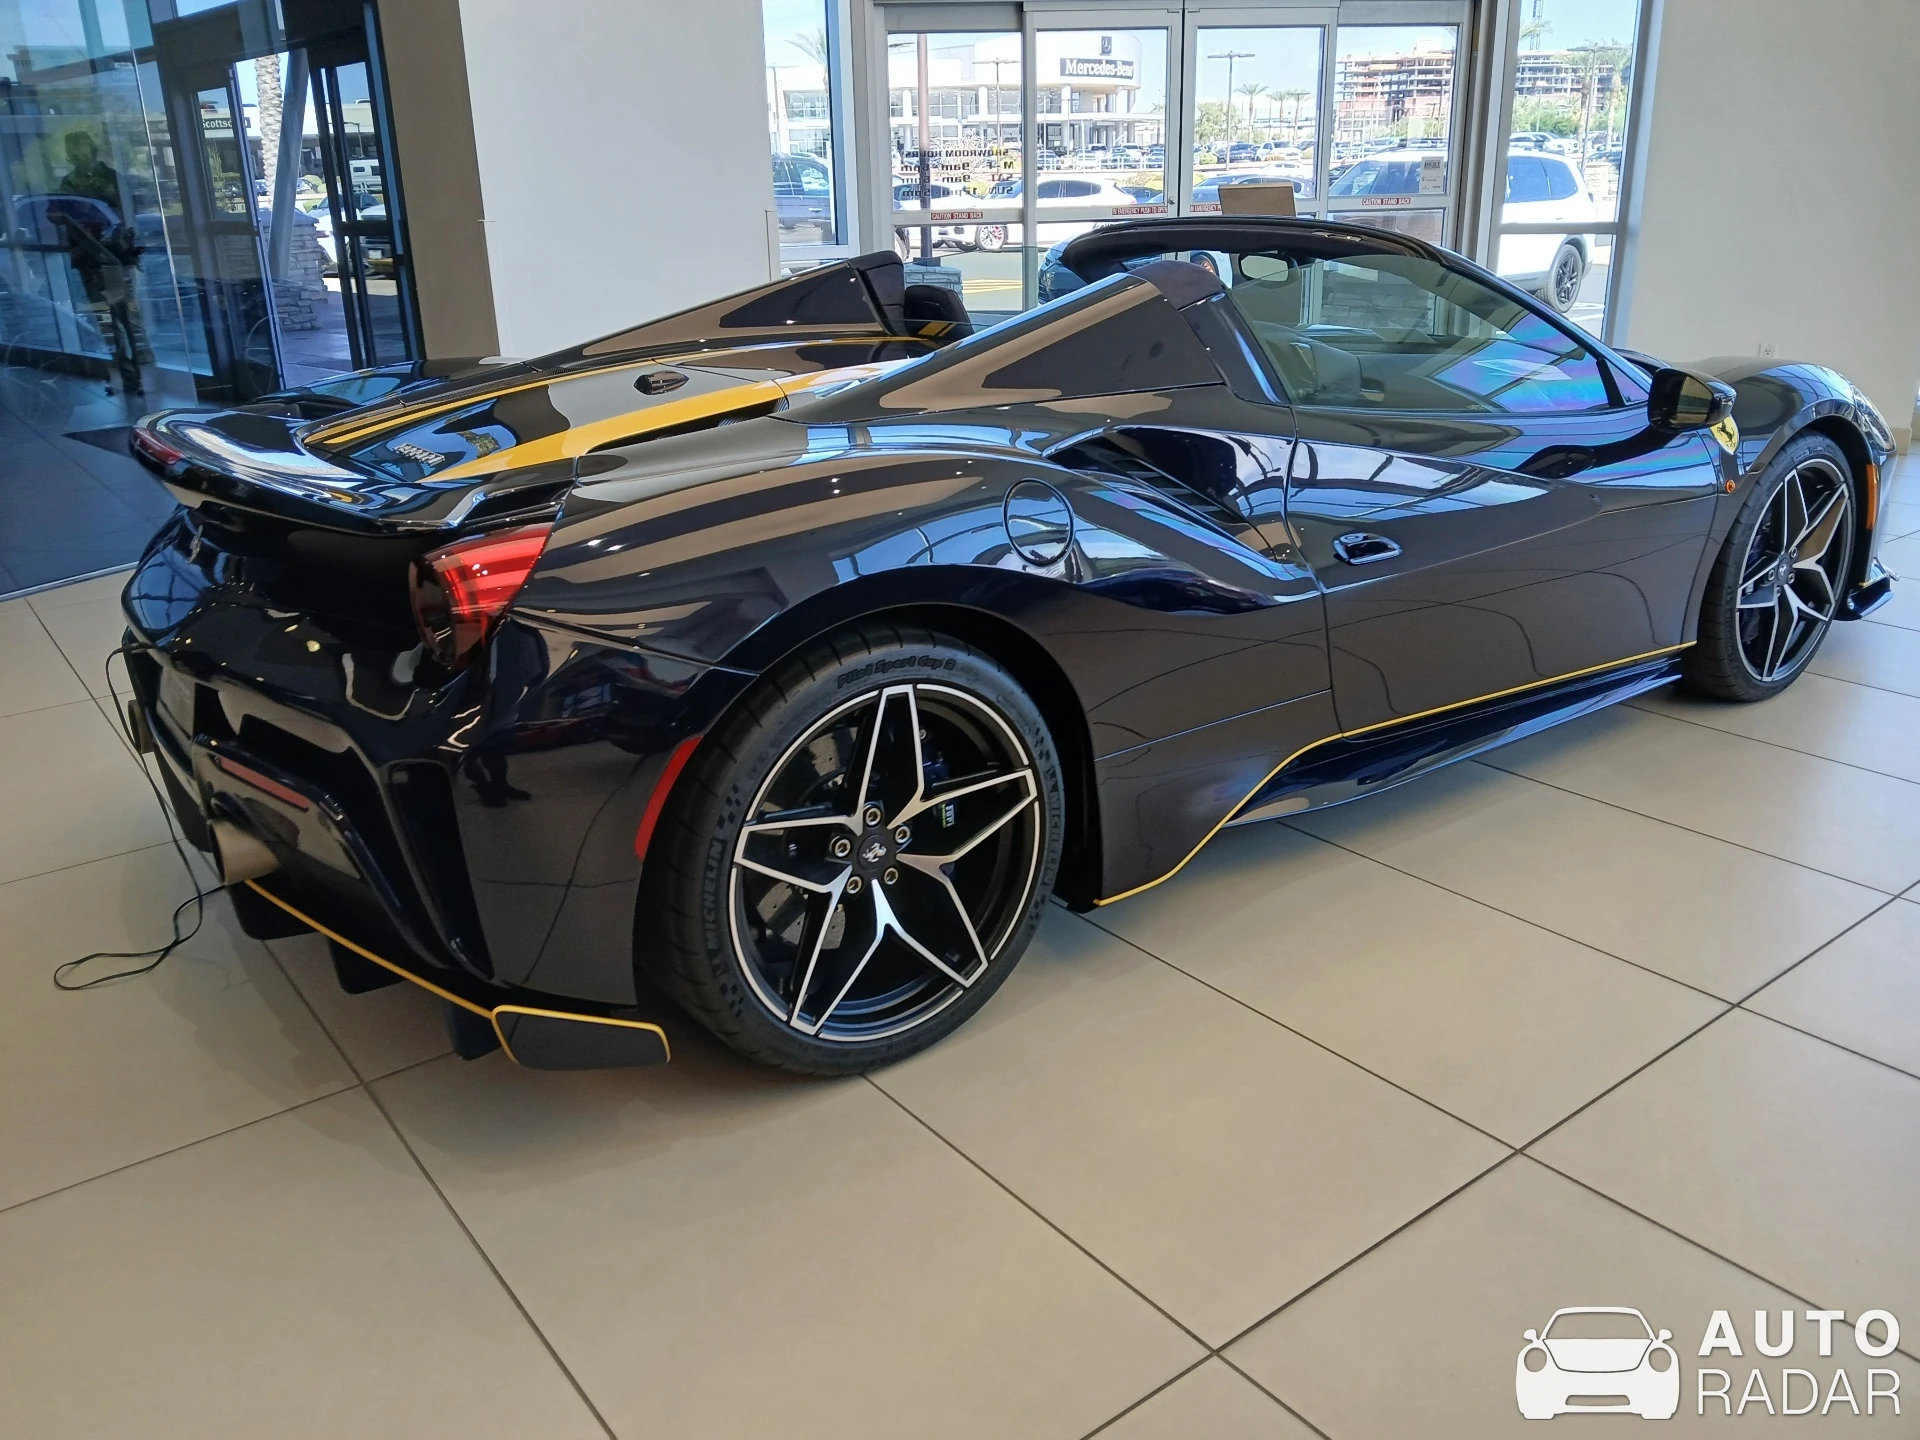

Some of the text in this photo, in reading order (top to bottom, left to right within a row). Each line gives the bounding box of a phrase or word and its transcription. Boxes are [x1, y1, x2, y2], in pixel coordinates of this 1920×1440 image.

[837, 655, 957, 689] Pilot Sport Cup 2
[703, 838, 724, 950] MICHELIN
